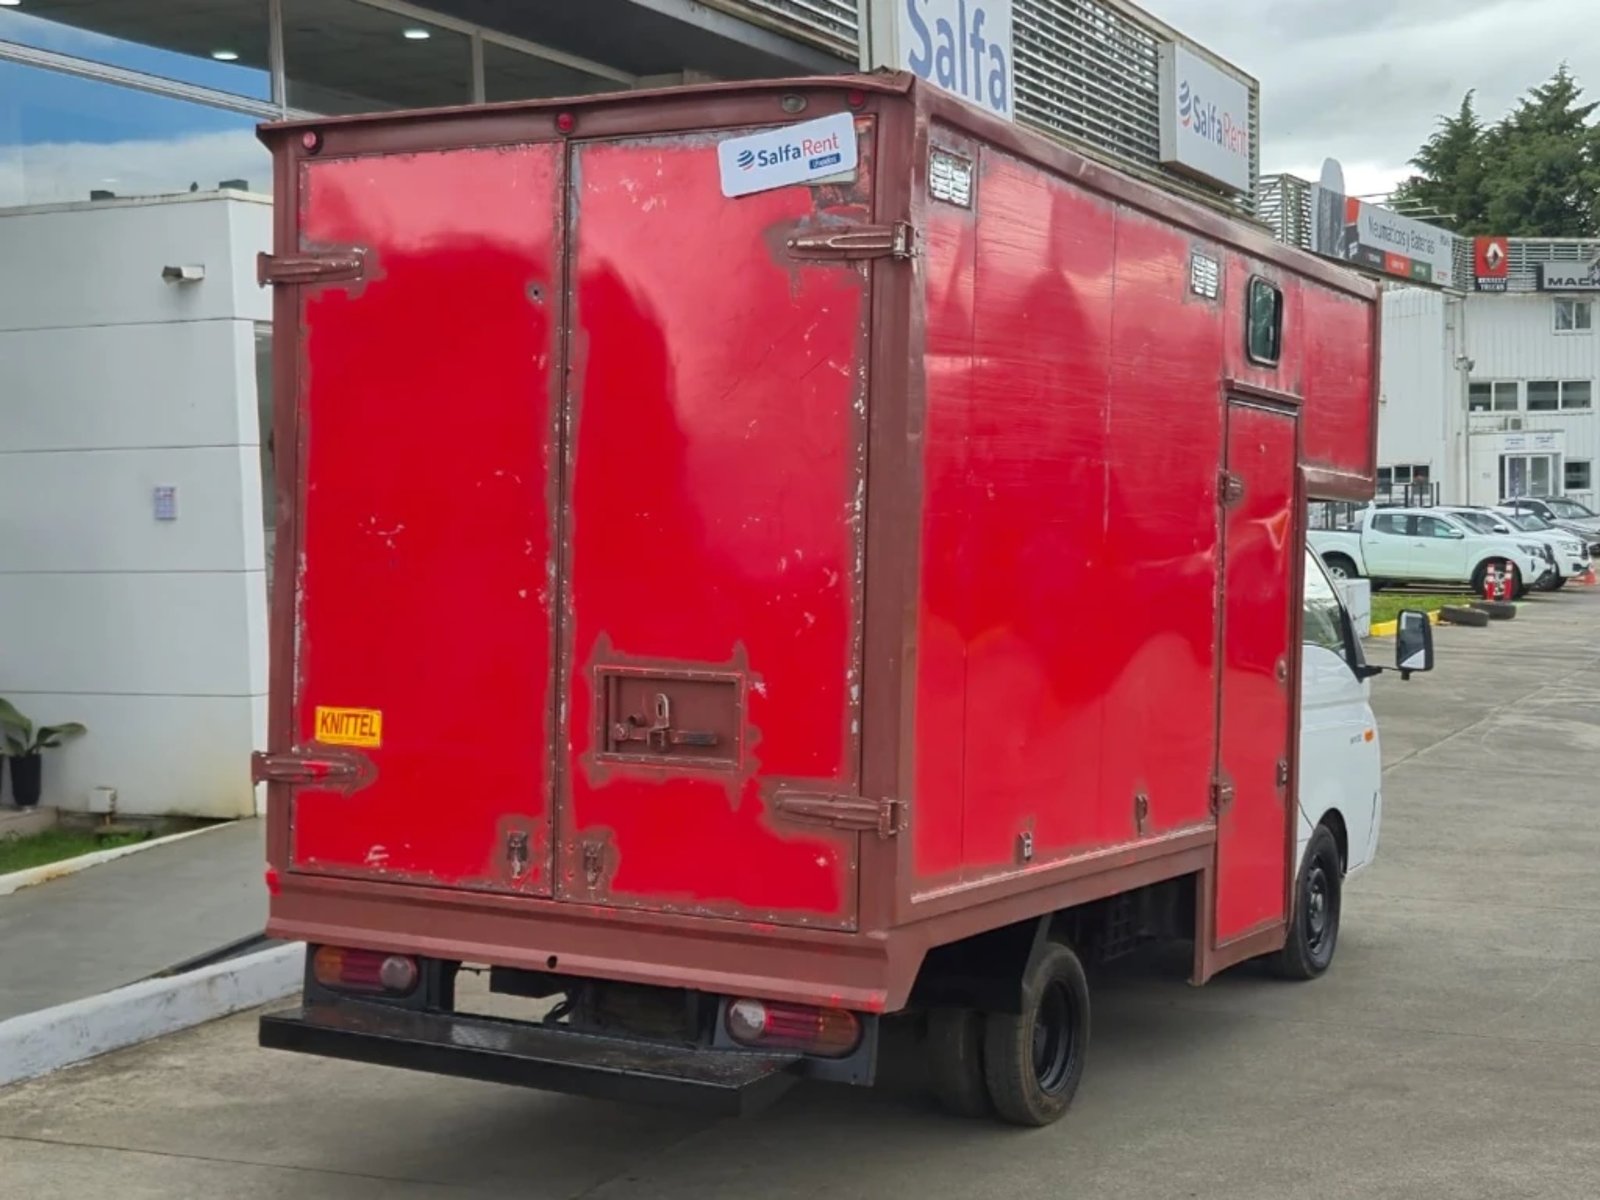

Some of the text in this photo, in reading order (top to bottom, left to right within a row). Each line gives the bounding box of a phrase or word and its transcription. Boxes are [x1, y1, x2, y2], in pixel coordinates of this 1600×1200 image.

[906, 0, 1007, 112] Salfa
[757, 132, 840, 167] SalfaRent
[1193, 95, 1247, 158] SalfaRent
[320, 711, 377, 737] KNITTEL
